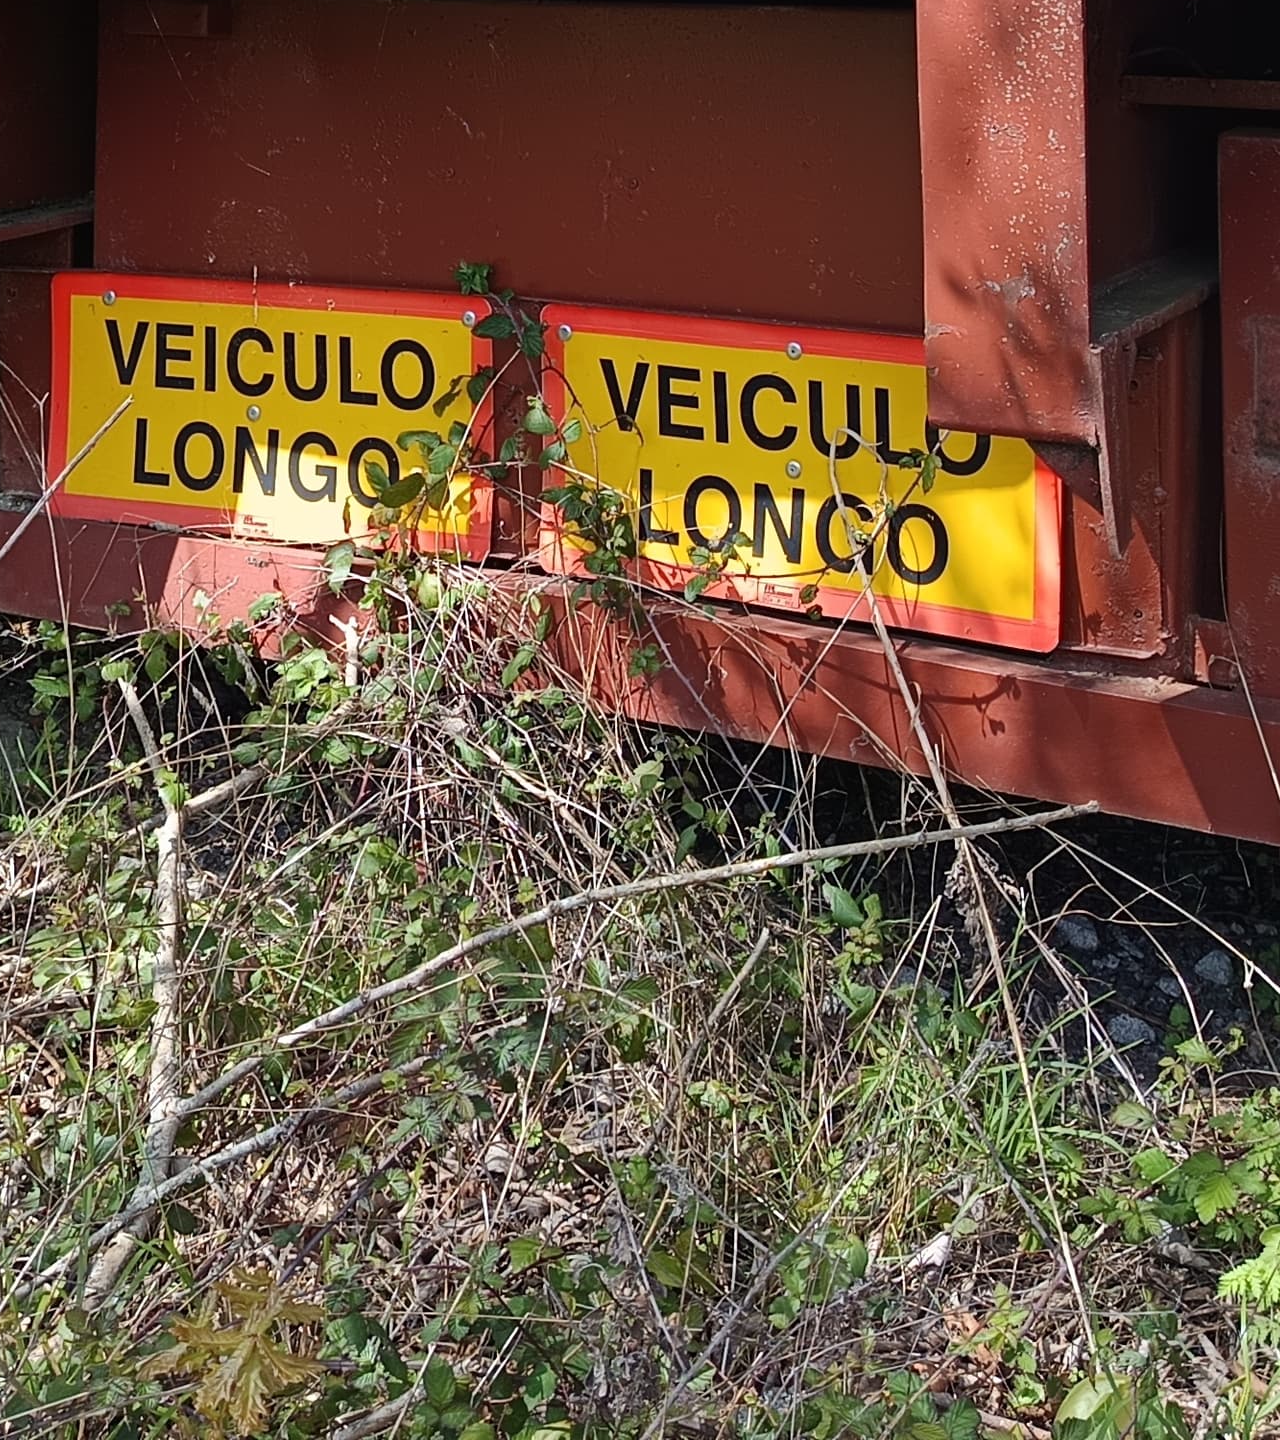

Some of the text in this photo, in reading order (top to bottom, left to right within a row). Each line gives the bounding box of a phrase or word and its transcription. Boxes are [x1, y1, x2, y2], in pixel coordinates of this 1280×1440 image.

[104, 318, 437, 411] VEICULO
[598, 357, 992, 476] VEICULO
[132, 417, 400, 509] LONGO
[638, 468, 949, 586] LONGO
